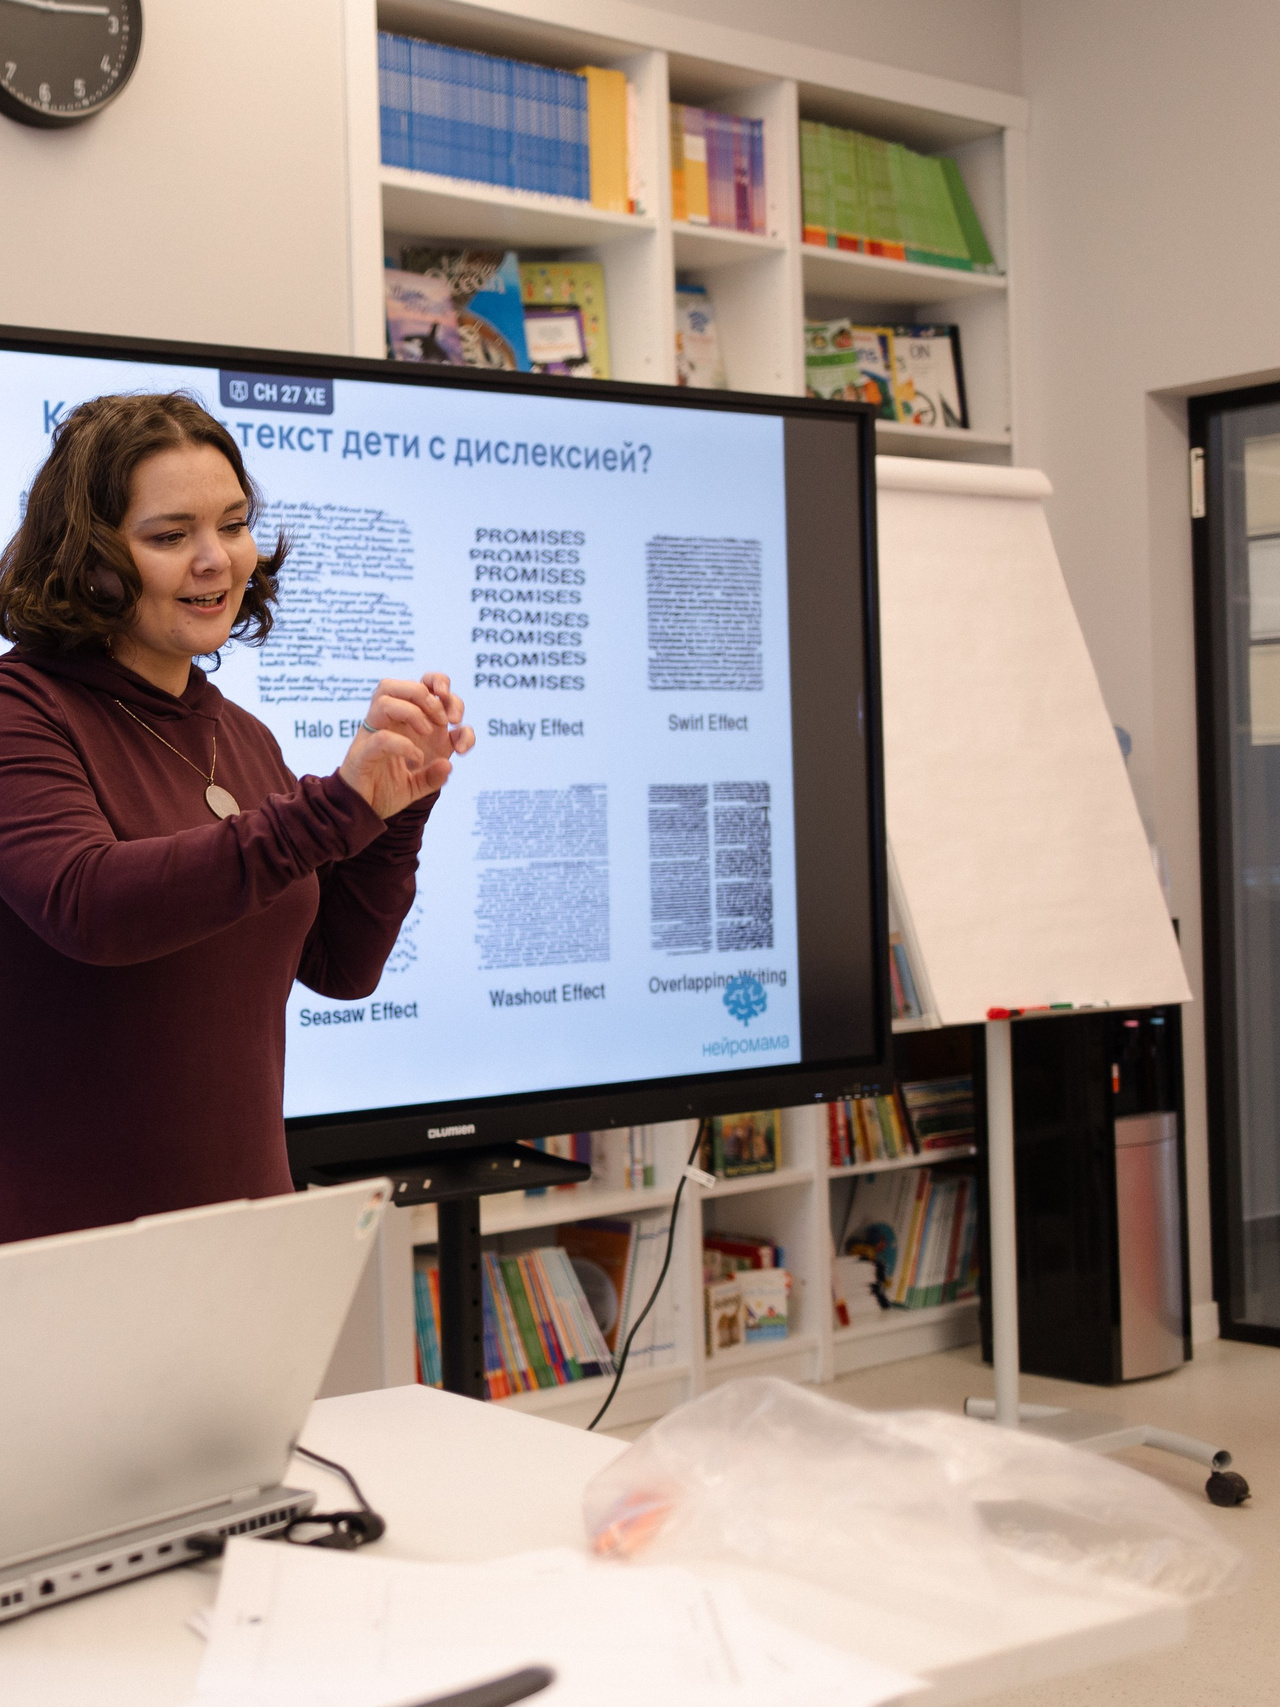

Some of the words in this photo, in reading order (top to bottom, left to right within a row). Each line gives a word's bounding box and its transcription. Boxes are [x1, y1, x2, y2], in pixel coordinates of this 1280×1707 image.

[108, 15, 119, 35] 3
[5, 61, 17, 80] 7
[100, 54, 111, 73] 4
[39, 82, 51, 102] 6
[73, 78, 86, 98] 5
[281, 385, 300, 404] 27
[236, 421, 333, 452] текст
[342, 429, 420, 459] дети
[429, 437, 446, 460] с
[454, 437, 652, 474] дислексией?
[475, 527, 586, 546] PROMISES
[469, 548, 580, 565] PROMISES
[475, 564, 586, 586] PROMISES
[471, 588, 582, 604] PROMISES
[479, 606, 589, 629] PROMISES
[472, 627, 582, 647] PROMISES
[476, 651, 587, 668] PROMISES
[474, 673, 585, 691] PROMISES
[295, 720, 333, 738] Halo
[488, 718, 536, 741] Shaky
[541, 718, 585, 738] Effect
[669, 714, 704, 731] Swirl
[709, 714, 748, 731] Effect
[490, 988, 558, 1008] Washout
[562, 983, 606, 1002] Effect
[300, 1005, 365, 1027] Seasaw
[371, 1001, 418, 1022] Effect
[703, 1035, 789, 1058] нейромама
